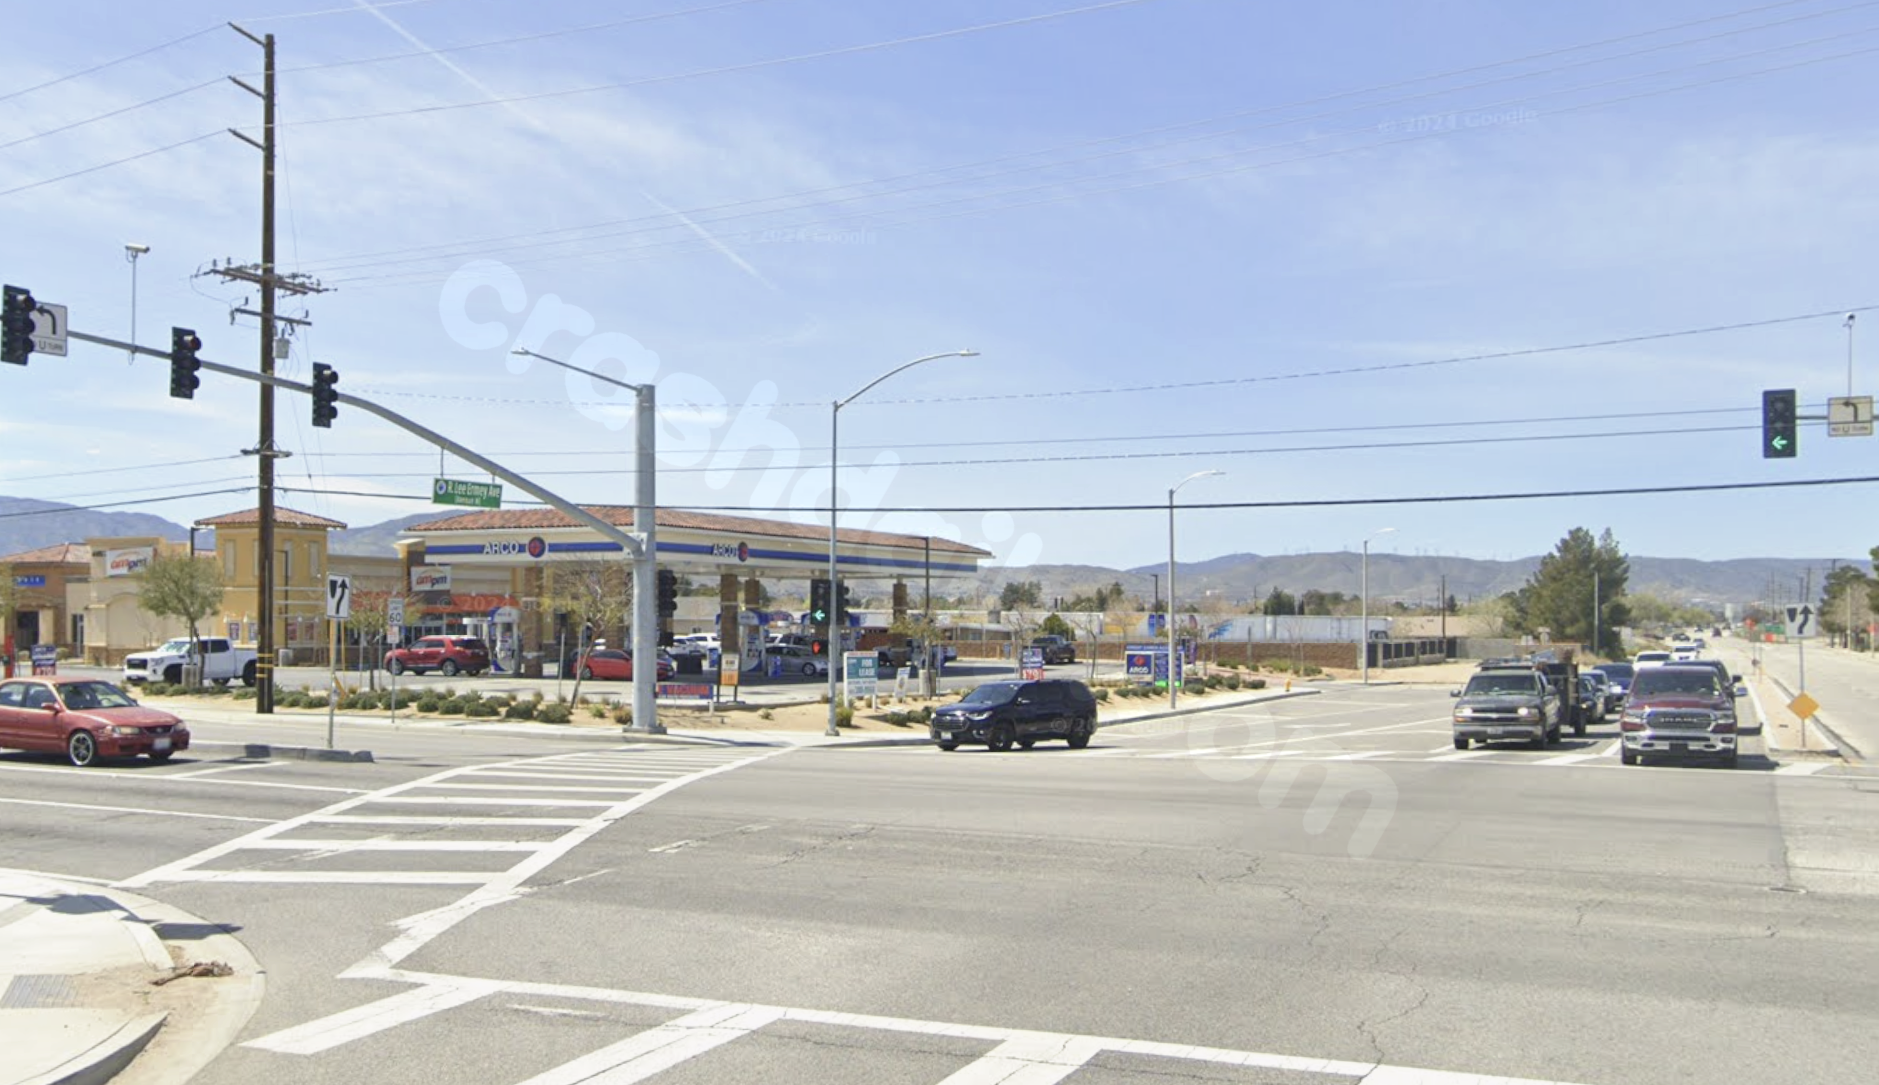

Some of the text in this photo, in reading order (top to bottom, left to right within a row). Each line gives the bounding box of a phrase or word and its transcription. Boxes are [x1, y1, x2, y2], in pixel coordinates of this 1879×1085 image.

[454, 481, 467, 496] Lee
[483, 541, 520, 555] ARCO
[712, 543, 737, 558] ARCO
[110, 557, 148, 572] ampm
[417, 574, 447, 588] ampm
[389, 612, 401, 623] 60
[1128, 666, 1149, 674] ARCO
